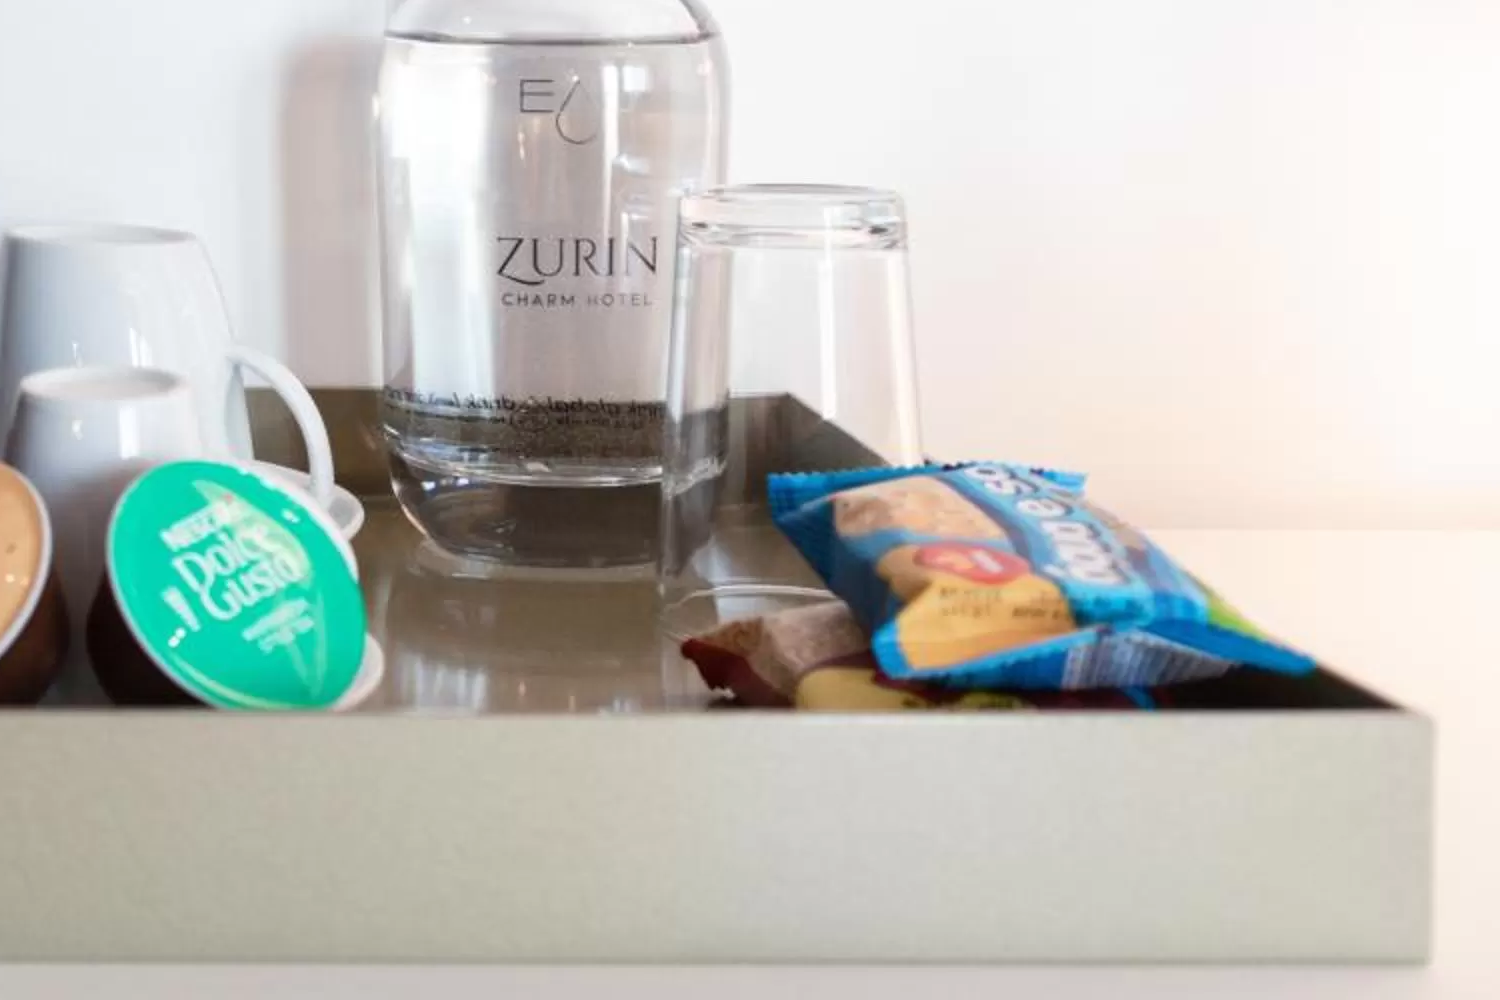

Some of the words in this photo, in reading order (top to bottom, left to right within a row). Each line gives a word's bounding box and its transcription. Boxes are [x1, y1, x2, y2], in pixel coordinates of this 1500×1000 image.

[497, 236, 658, 286] ZURIN
[501, 293, 576, 308] CHARM
[587, 293, 653, 308] HOTEL
